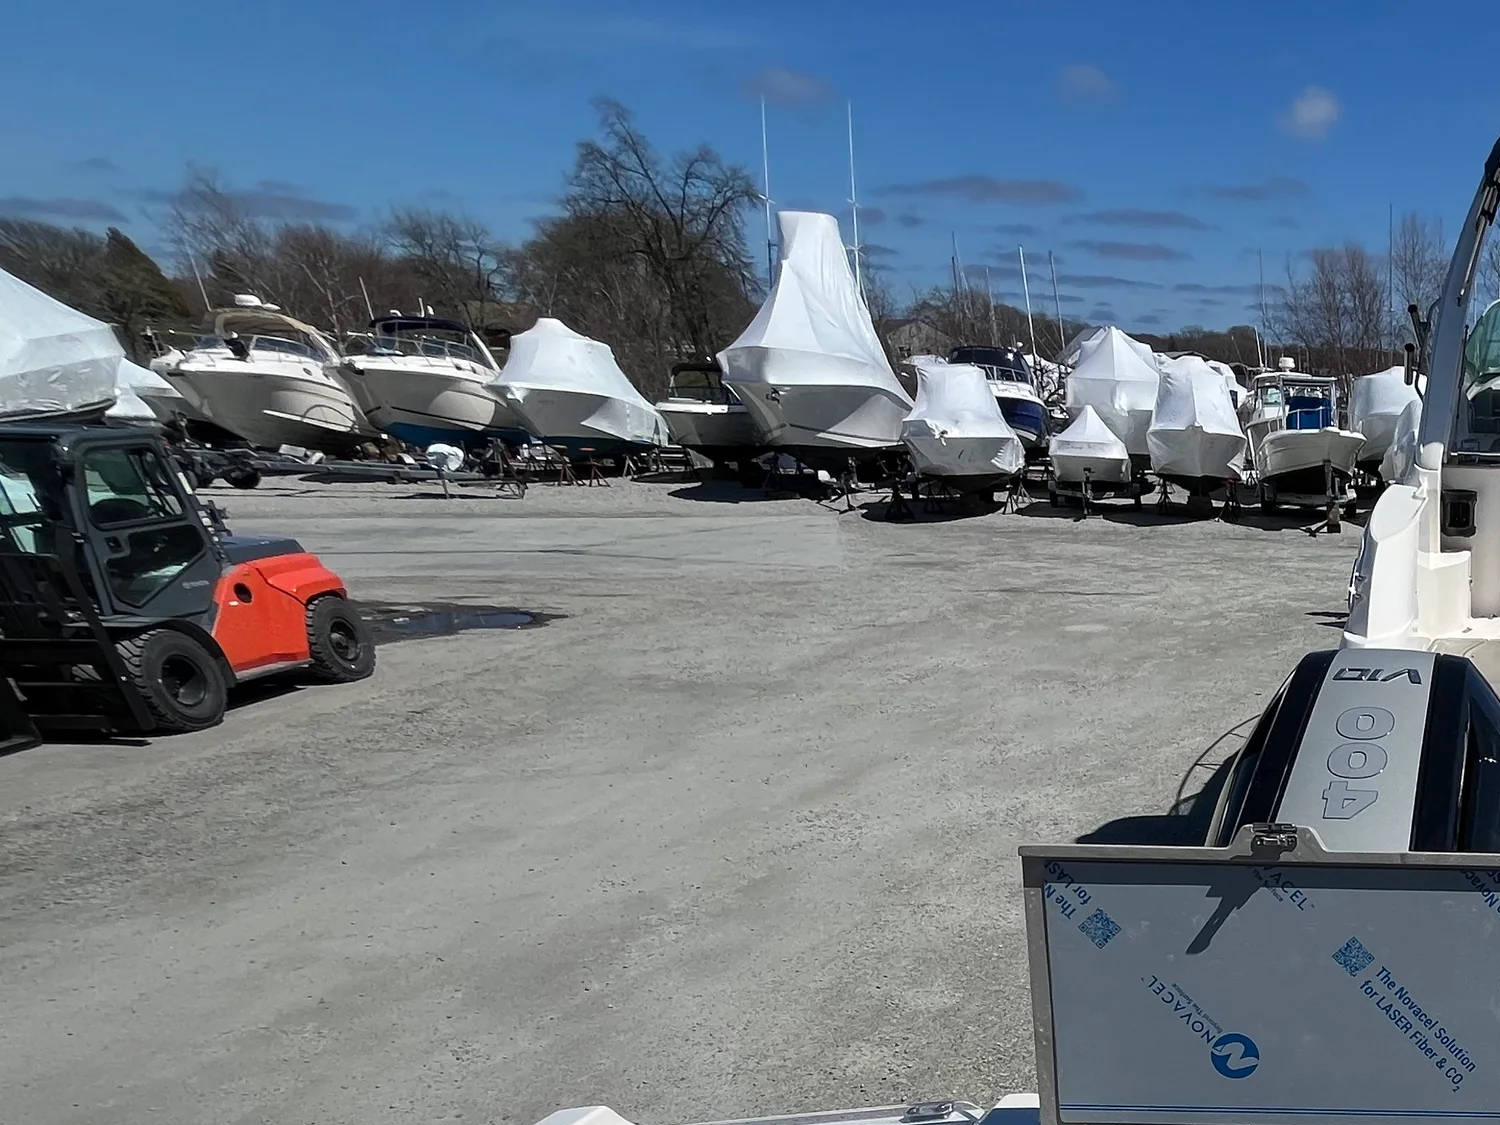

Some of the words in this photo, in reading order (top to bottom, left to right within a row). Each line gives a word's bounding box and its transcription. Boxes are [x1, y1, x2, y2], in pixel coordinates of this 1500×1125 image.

[1332, 667, 1422, 685] V10
[1322, 706, 1396, 820] 400
[1055, 895, 1077, 920] The
[1072, 885, 1093, 906] for
[1264, 866, 1308, 911] ACEL
[1148, 975, 1216, 1044] NOVACEL
[1360, 980, 1378, 999] for
[1376, 996, 1413, 1034] LASER
[1409, 1030, 1438, 1060] Fiber
[1435, 1058, 1447, 1070] &
[1376, 966, 1397, 991] The
[1394, 986, 1439, 1030] Novacel
[1434, 1027, 1476, 1073] Solution
